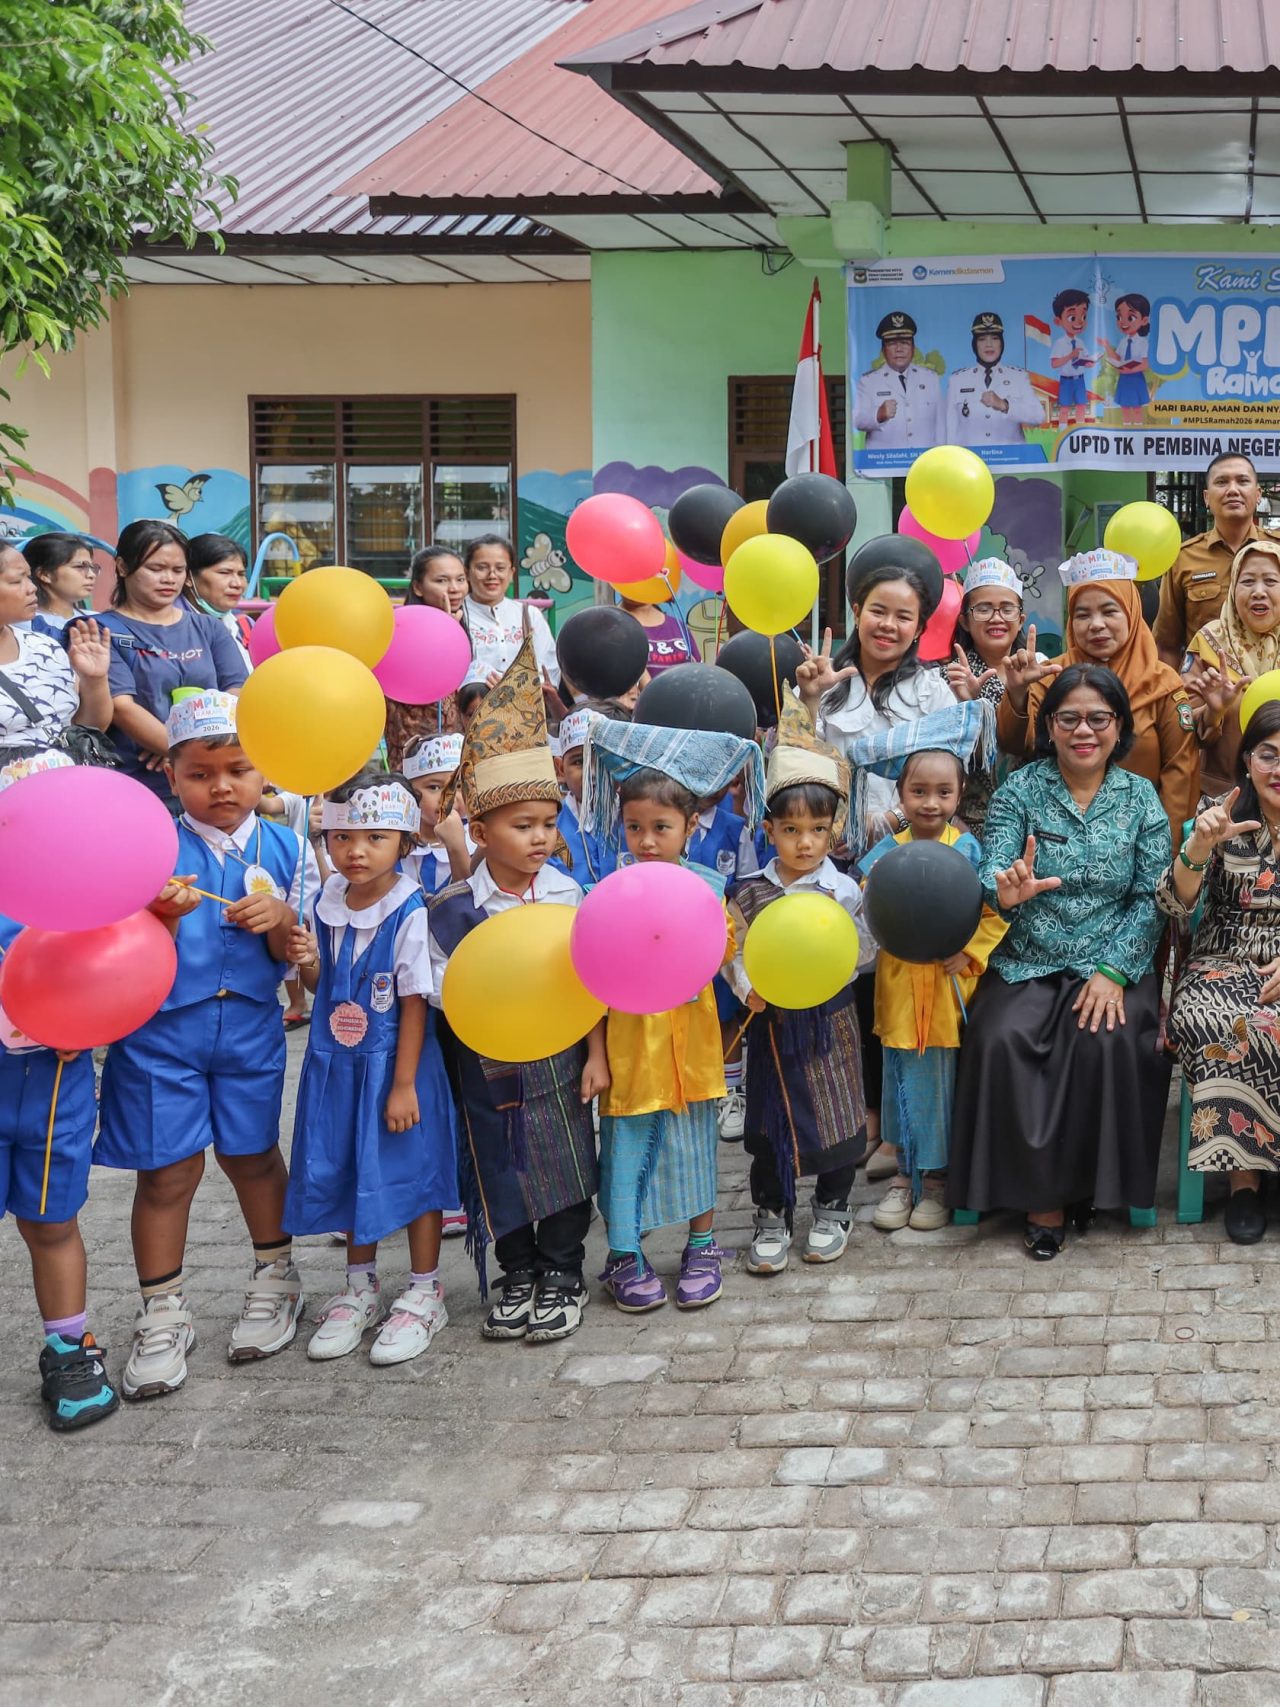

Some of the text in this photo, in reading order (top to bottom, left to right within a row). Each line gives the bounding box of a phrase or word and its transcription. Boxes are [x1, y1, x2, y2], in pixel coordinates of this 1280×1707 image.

[1198, 266, 1260, 290] Kami
[1154, 404, 1178, 413] HARI
[1180, 404, 1210, 414] BARU,
[1211, 405, 1241, 413] AMAN
[1243, 405, 1265, 413] DAN
[1183, 417, 1253, 425] #MPLSRamah2026
[1069, 435, 1110, 454] UPTD
[1114, 436, 1134, 455] TK
[1143, 437, 1223, 456] PEMBINA
[1088, 553, 1113, 564] MPLS
[192, 696, 229, 710] MPLS
[203, 724, 220, 732] 2026
